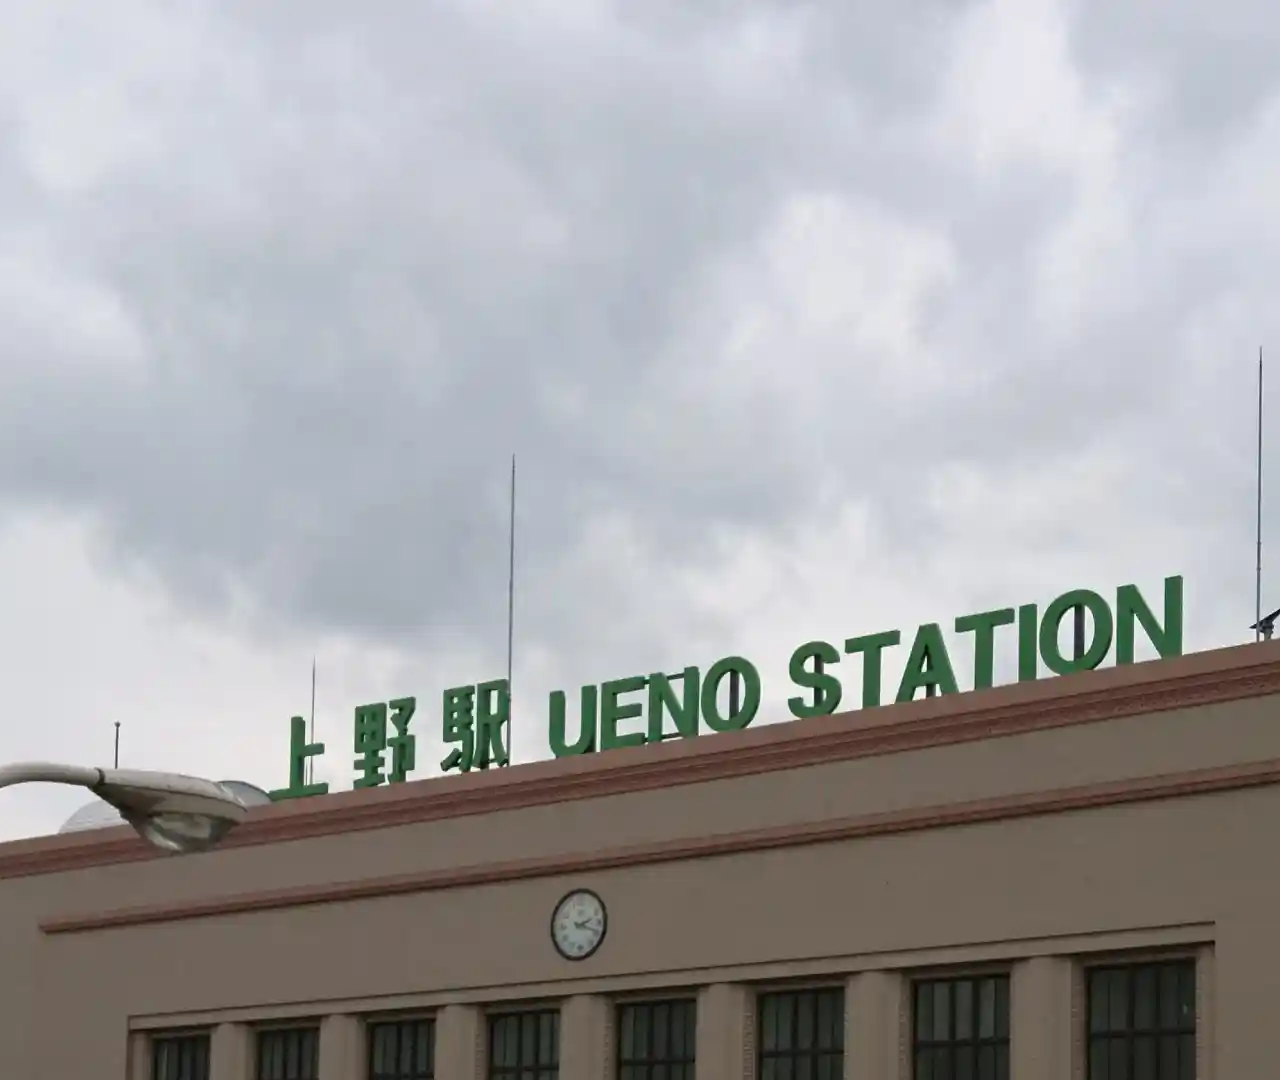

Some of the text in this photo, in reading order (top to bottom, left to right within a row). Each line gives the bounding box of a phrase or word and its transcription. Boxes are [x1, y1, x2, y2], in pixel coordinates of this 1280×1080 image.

[269, 678, 510, 800] 上野駅
[549, 574, 1184, 757] UENO STATION
